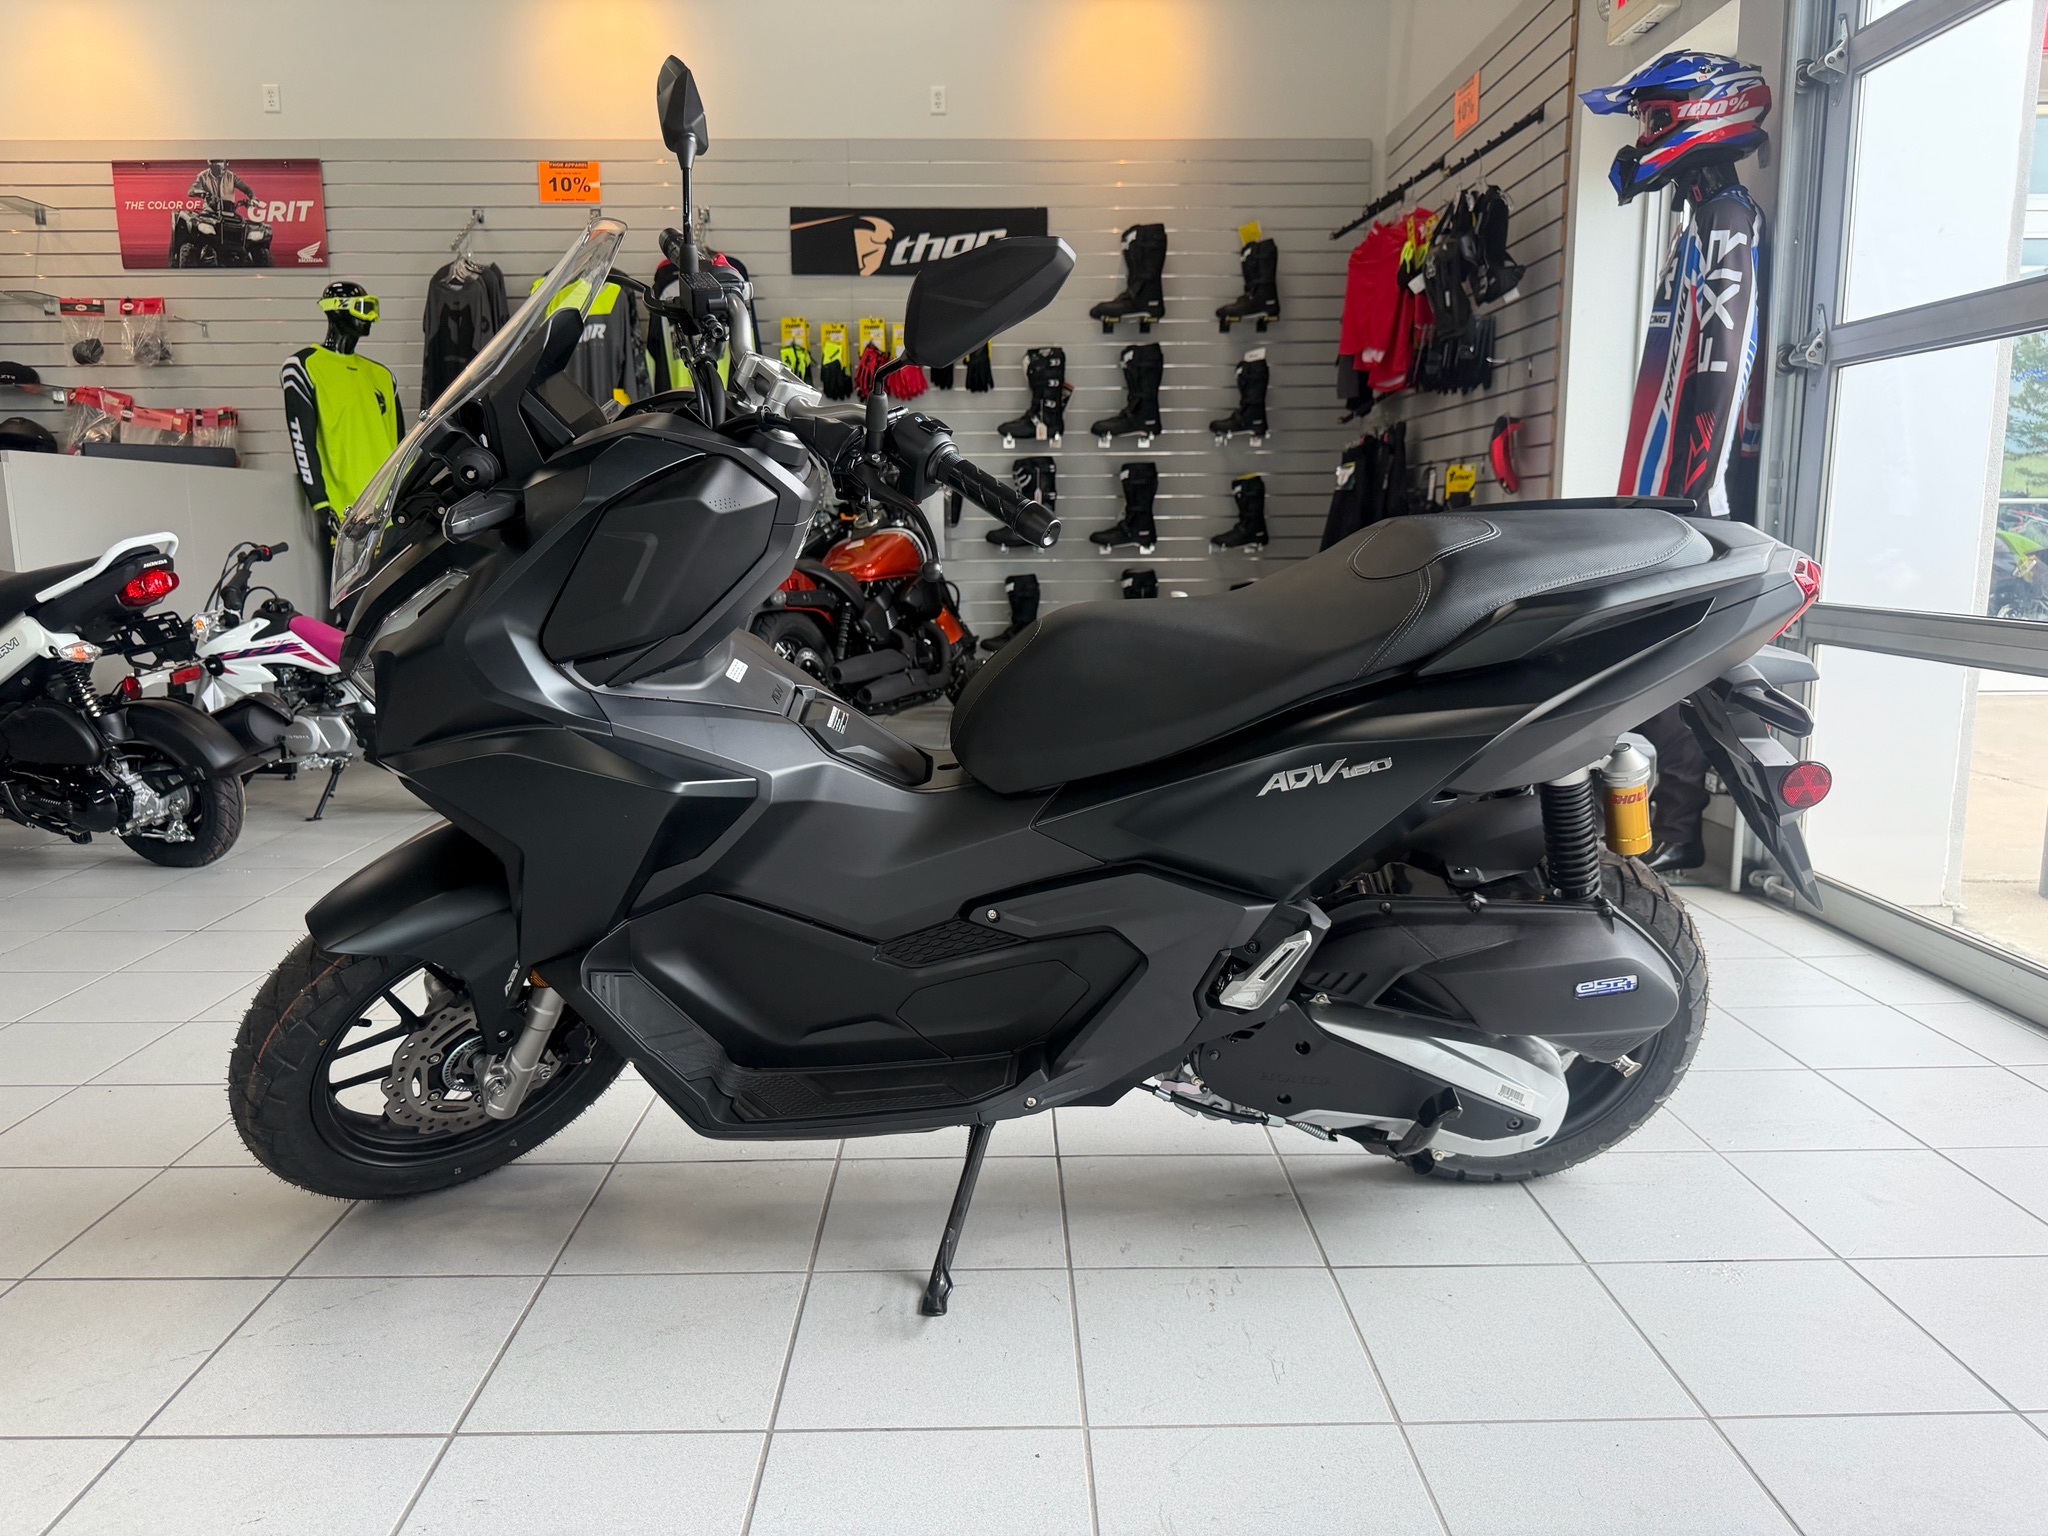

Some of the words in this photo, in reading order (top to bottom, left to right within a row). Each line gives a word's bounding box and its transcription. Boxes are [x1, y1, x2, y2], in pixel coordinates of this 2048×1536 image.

[1677, 93, 1749, 119] 100%
[549, 177, 591, 192] 10%
[125, 201, 144, 210] THE
[147, 201, 182, 210] COLOR
[186, 200, 201, 210] OF
[247, 200, 314, 222] GRIT
[890, 229, 1008, 266] thor
[579, 323, 607, 343] OR
[1664, 283, 1690, 412] RACING
[290, 416, 314, 486] THOR
[143, 559, 168, 568] HONDA
